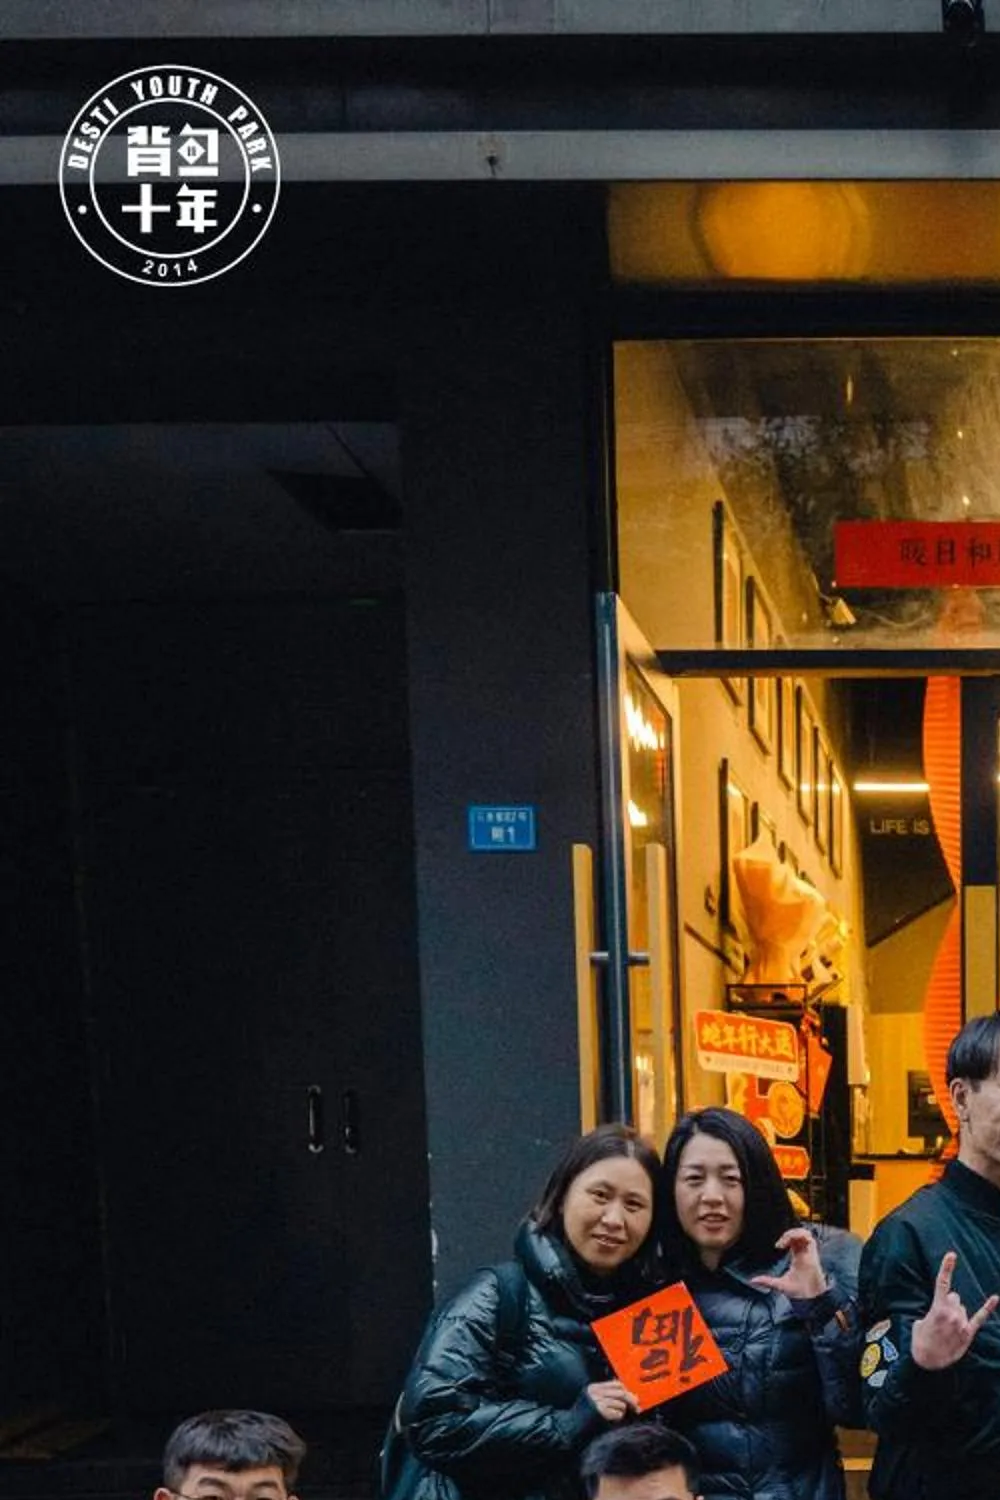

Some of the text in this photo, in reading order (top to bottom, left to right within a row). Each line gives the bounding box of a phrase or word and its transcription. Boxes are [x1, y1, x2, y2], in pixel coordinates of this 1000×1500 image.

[870, 818, 908, 835] LIFE
[913, 818, 930, 835] IS
[631, 1305, 708, 1385] 福
